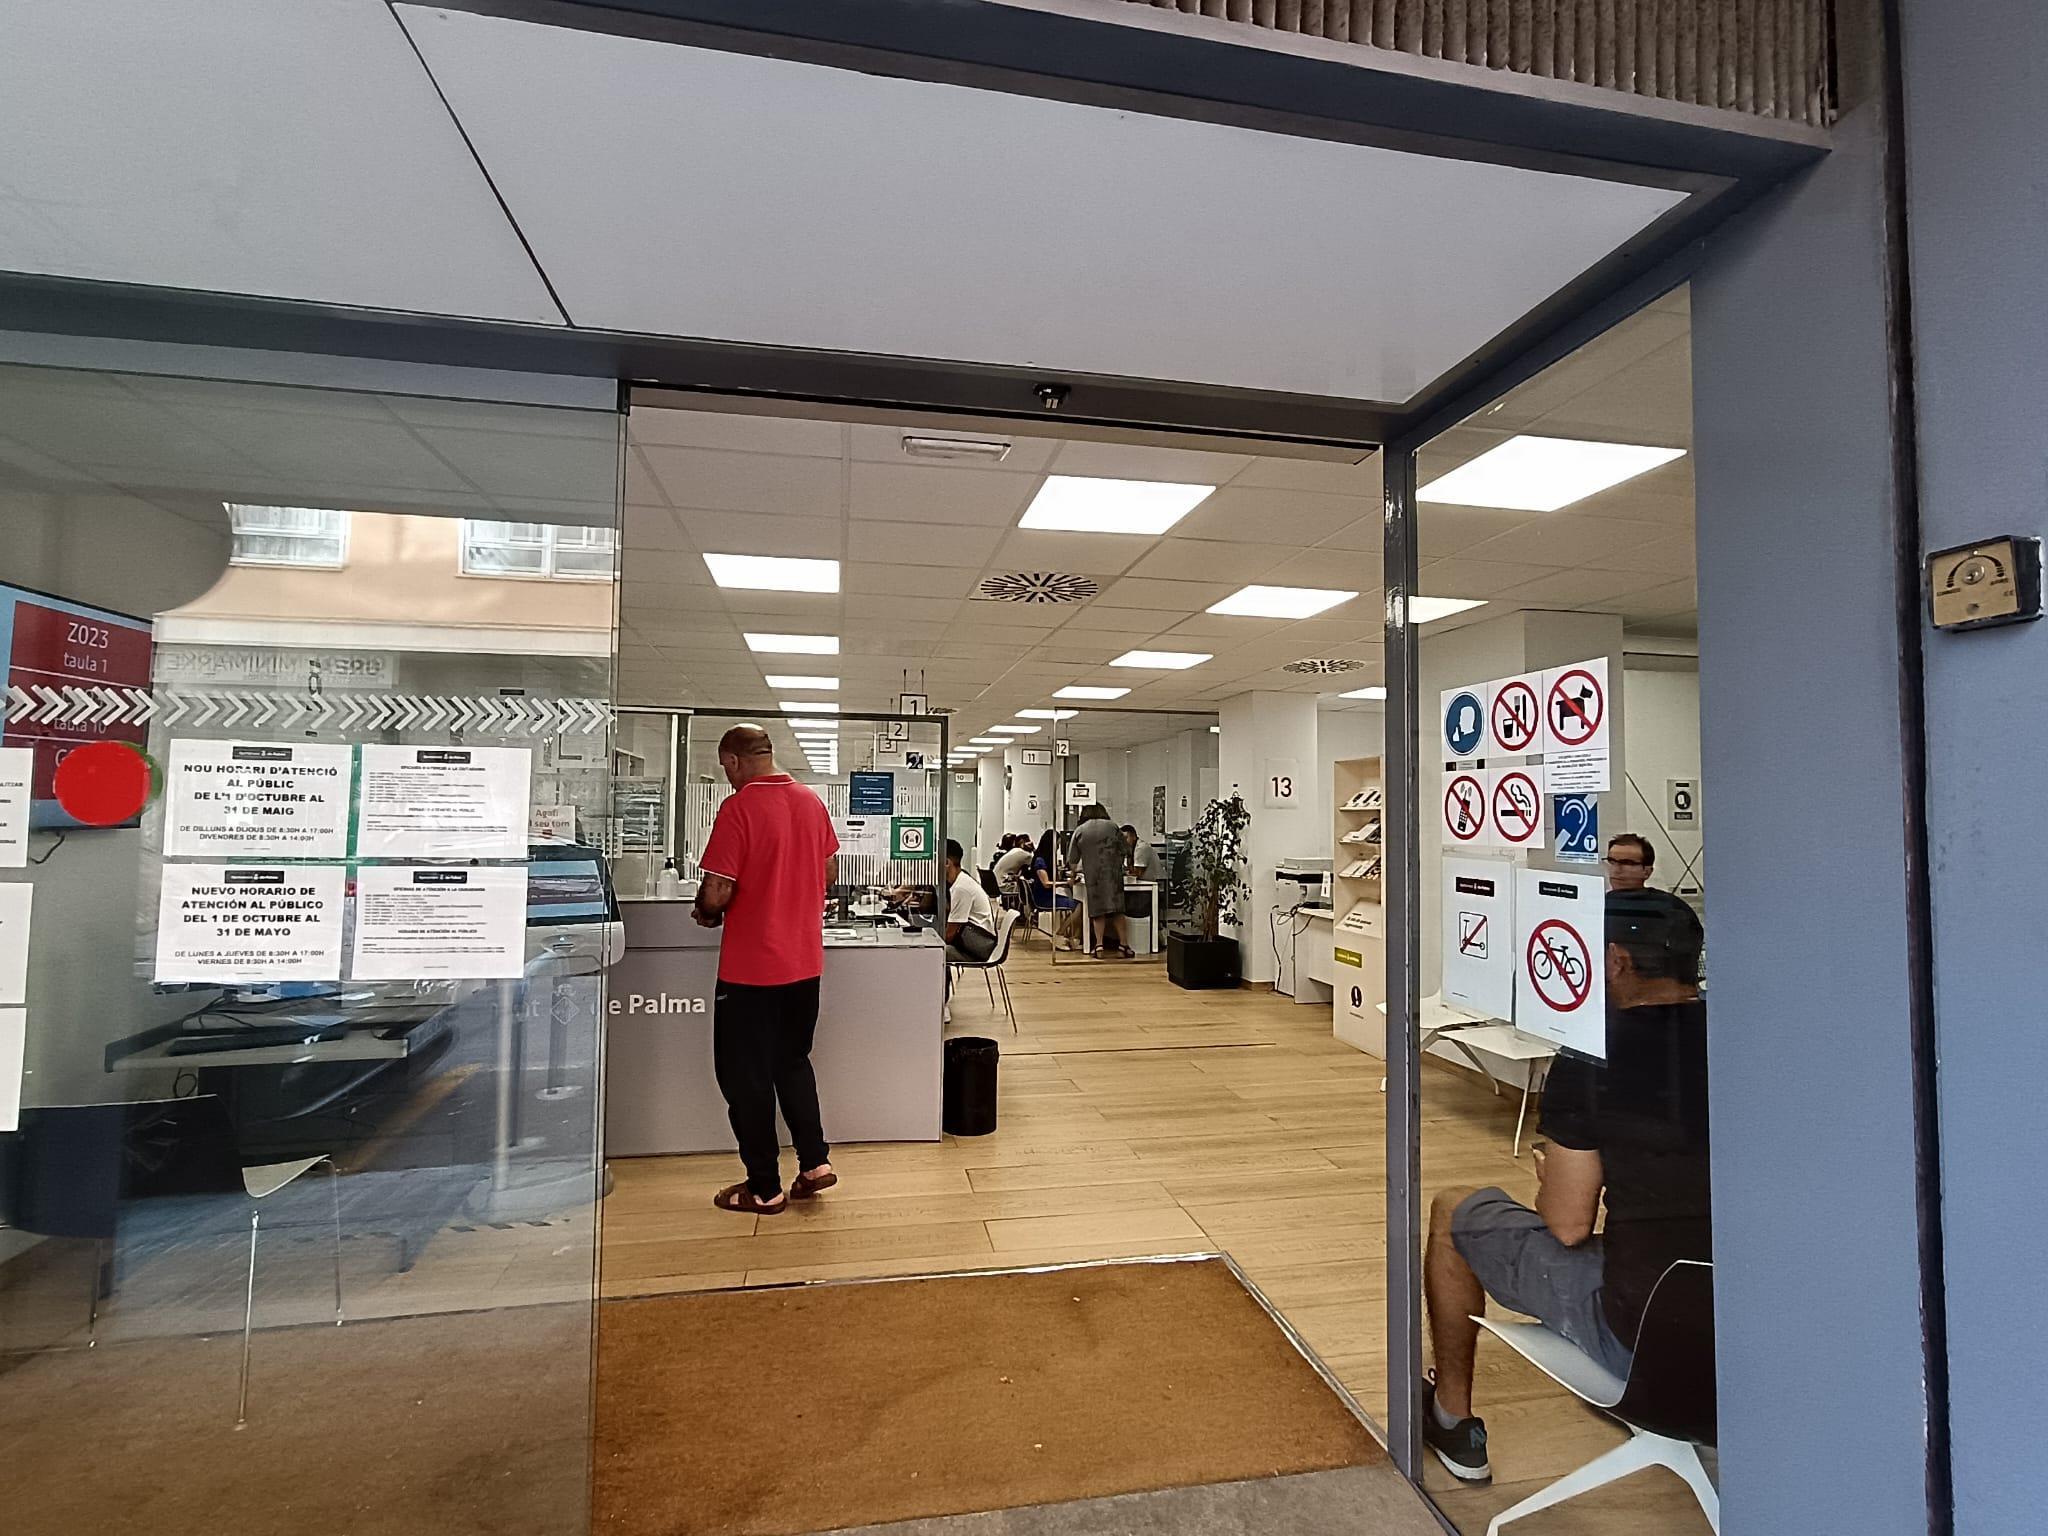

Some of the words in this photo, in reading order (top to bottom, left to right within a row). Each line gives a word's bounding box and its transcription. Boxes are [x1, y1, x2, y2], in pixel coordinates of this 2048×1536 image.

[67, 622, 109, 649] Z023
[64, 651, 97, 672] taula
[101, 659, 108, 673] 1
[910, 699, 918, 716] 1
[893, 722, 903, 737] 2
[885, 739, 892, 750] 3
[1056, 743, 1067, 755] 12
[1027, 753, 1036, 763] 11
[184, 764, 212, 773] NOU
[216, 765, 265, 774] HORARI
[269, 765, 338, 777] D'ATENCIÓ
[226, 779, 244, 788] AL
[247, 777, 295, 789] PÚBLIC
[1270, 775, 1293, 799] 13
[194, 792, 211, 801] DE
[235, 792, 306, 802] D'OCTUBRE
[309, 794, 325, 803] AL
[223, 806, 238, 815] 31
[242, 806, 259, 815] DE
[262, 807, 295, 816] MAIG
[535, 808, 559, 818] Agafi
[551, 820, 570, 828] torn
[199, 833, 245, 841] DIVENDRES
[1586, 837, 1594, 849] T
[191, 887, 236, 896] NUEVO
[239, 887, 296, 896] HORARIO
[299, 887, 316, 896] DE
[181, 899, 247, 910] ATENCIÓN
[250, 900, 266, 909] AL
[269, 899, 324, 909] PÚBLICO
[183, 914, 208, 923] DEL
[211, 914, 218, 923] 1
[222, 914, 239, 923] DE
[242, 914, 302, 923] OCTUBRE
[305, 914, 321, 923] AL
[216, 928, 231, 937] 31
[234, 928, 251, 937] DE
[254, 928, 291, 937] MAYO
[628, 992, 706, 1015] Palma
